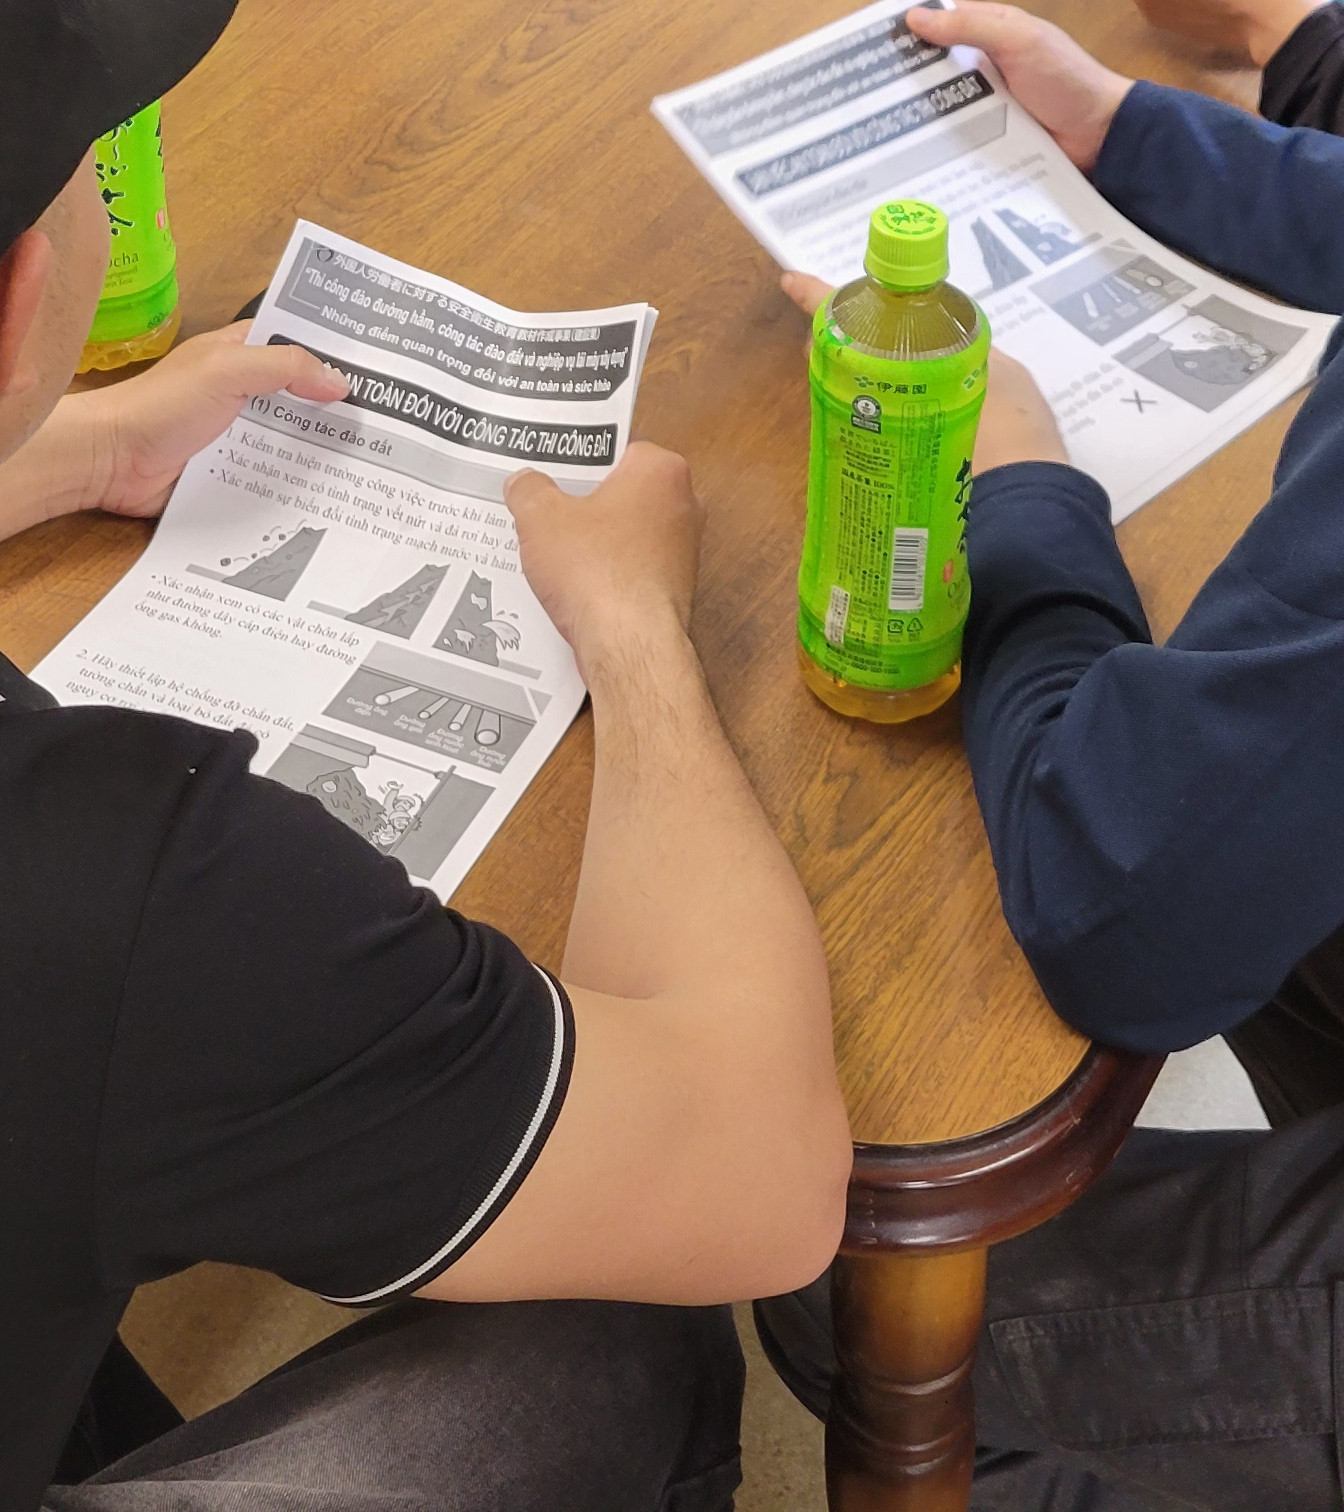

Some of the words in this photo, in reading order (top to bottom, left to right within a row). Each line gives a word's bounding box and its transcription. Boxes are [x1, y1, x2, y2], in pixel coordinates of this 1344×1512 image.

[323, 274, 350, 302] công
[350, 287, 370, 307] đào
[437, 321, 465, 347] công
[466, 333, 484, 353] tác
[484, 342, 506, 362] đào
[506, 347, 524, 367] đất
[320, 304, 367, 335] Những
[401, 337, 435, 358] quan
[436, 349, 472, 376] trọng
[473, 365, 496, 383] đối
[497, 370, 519, 389] với
[518, 379, 535, 391] an
[535, 376, 560, 393] toàn
[560, 377, 574, 393] và
[574, 377, 593, 394] sức
[876, 381, 927, 395] 伊藤園
[250, 394, 271, 414] (1)
[273, 405, 312, 431] Công
[314, 420, 337, 437] tác
[339, 429, 366, 447] đào
[369, 437, 393, 457] đất
[461, 415, 508, 446] CÔNG
[507, 424, 538, 454] TÁC
[535, 430, 558, 457] THI
[557, 428, 594, 458] CÔNG
[226, 448, 253, 468] Xác
[252, 456, 281, 480] nhận
[282, 472, 307, 489] xem
[310, 479, 327, 494] có
[327, 486, 350, 504] tình
[352, 495, 383, 519] trạng
[385, 503, 404, 523] vết
[428, 520, 442, 533] và
[479, 530, 502, 551] hay
[276, 446, 293, 462] tra
[296, 450, 322, 471] hiện
[366, 476, 397, 499] công
[399, 488, 426, 508] việc
[428, 498, 461, 518] trước
[462, 505, 483, 523] khi
[484, 510, 507, 529] làm
[216, 468, 243, 488] Xác
[243, 478, 274, 501] nhận
[344, 512, 370, 533] tình
[370, 523, 404, 546] trạng
[404, 533, 439, 553] mạch
[439, 544, 472, 563] nước
[156, 574, 188, 592] Xác
[184, 581, 216, 602] nhận
[215, 593, 244, 610] xem
[262, 607, 285, 623] các
[157, 611, 182, 628] gas
[76, 648, 89, 661] 2.
[237, 618, 261, 634] cáp
[290, 634, 316, 652] hay
[65, 678, 100, 698] nguy
